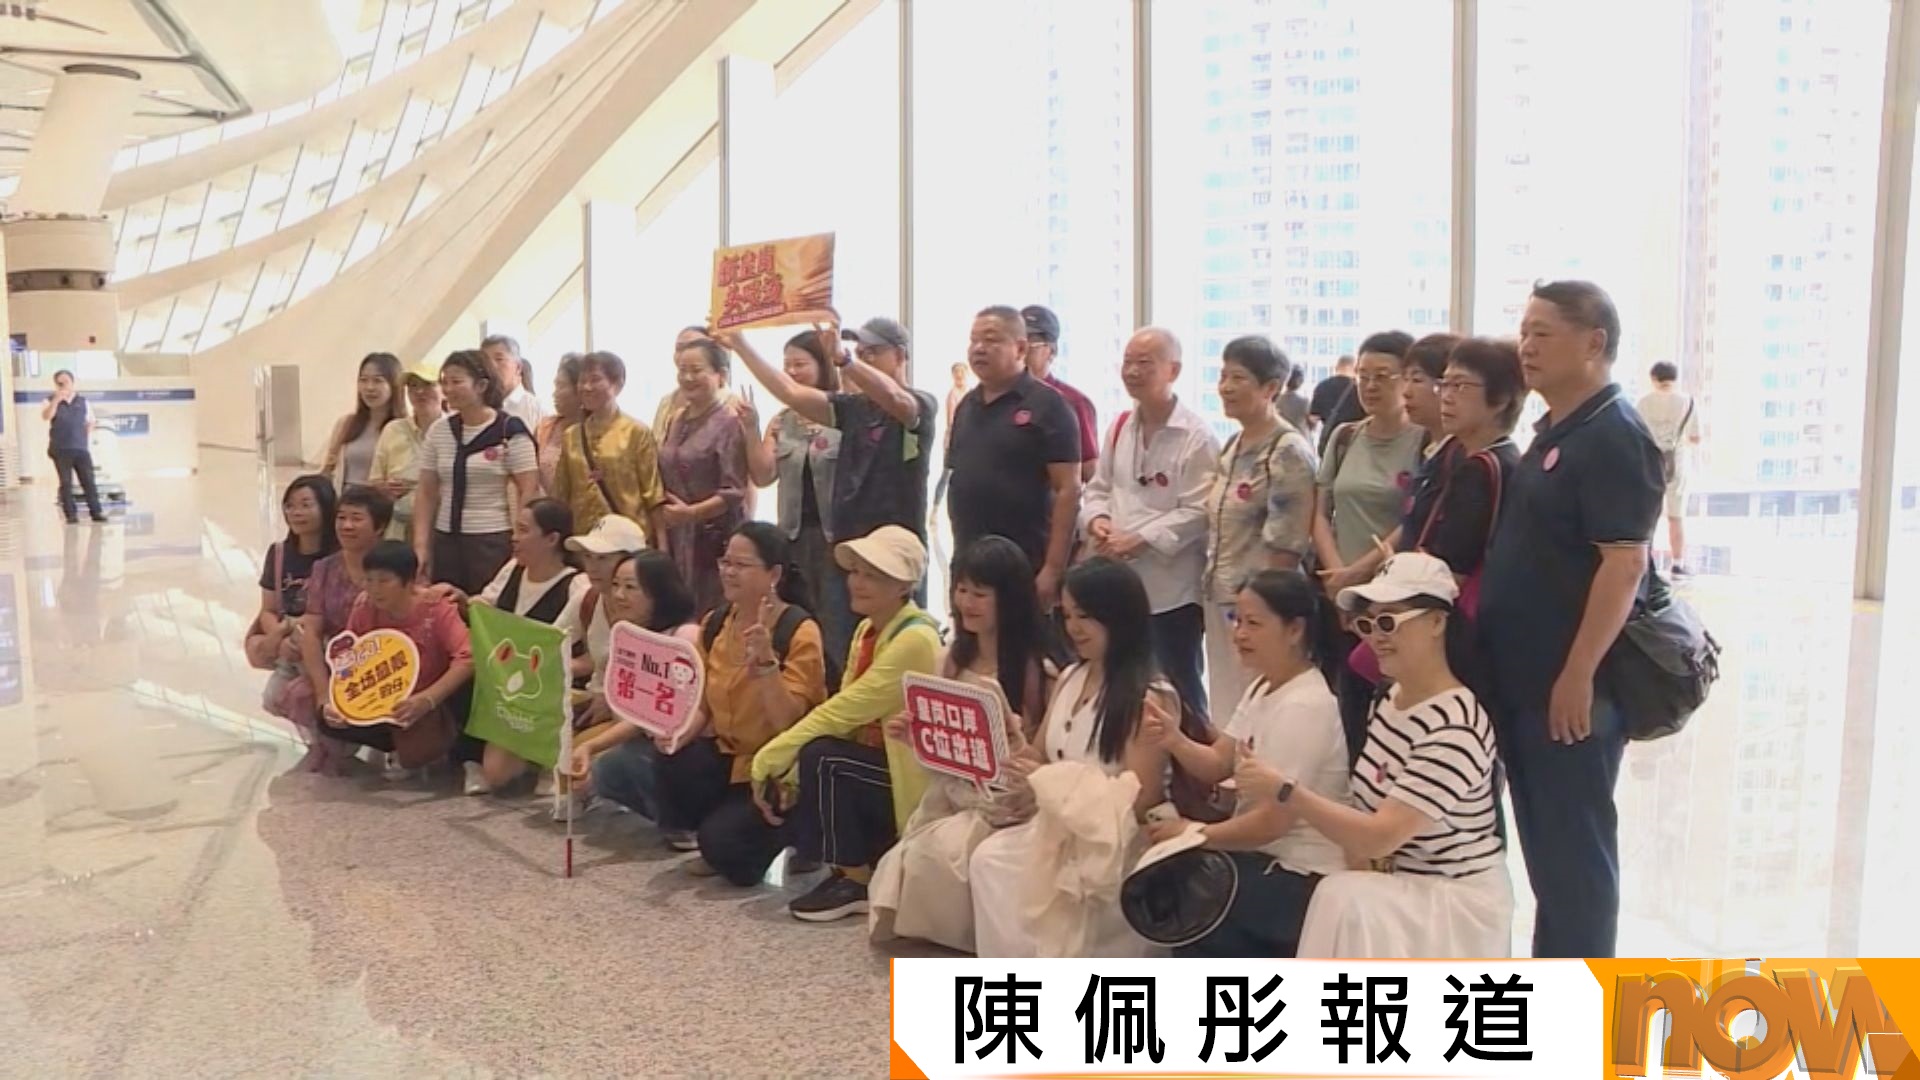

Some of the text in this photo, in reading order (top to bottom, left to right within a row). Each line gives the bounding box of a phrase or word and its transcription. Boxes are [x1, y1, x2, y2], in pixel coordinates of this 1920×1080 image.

[641, 653, 671, 679] No.1
[617, 668, 675, 716] 第一名
[916, 696, 978, 734] 皇岗口岸
[920, 726, 991, 772] C位出道
